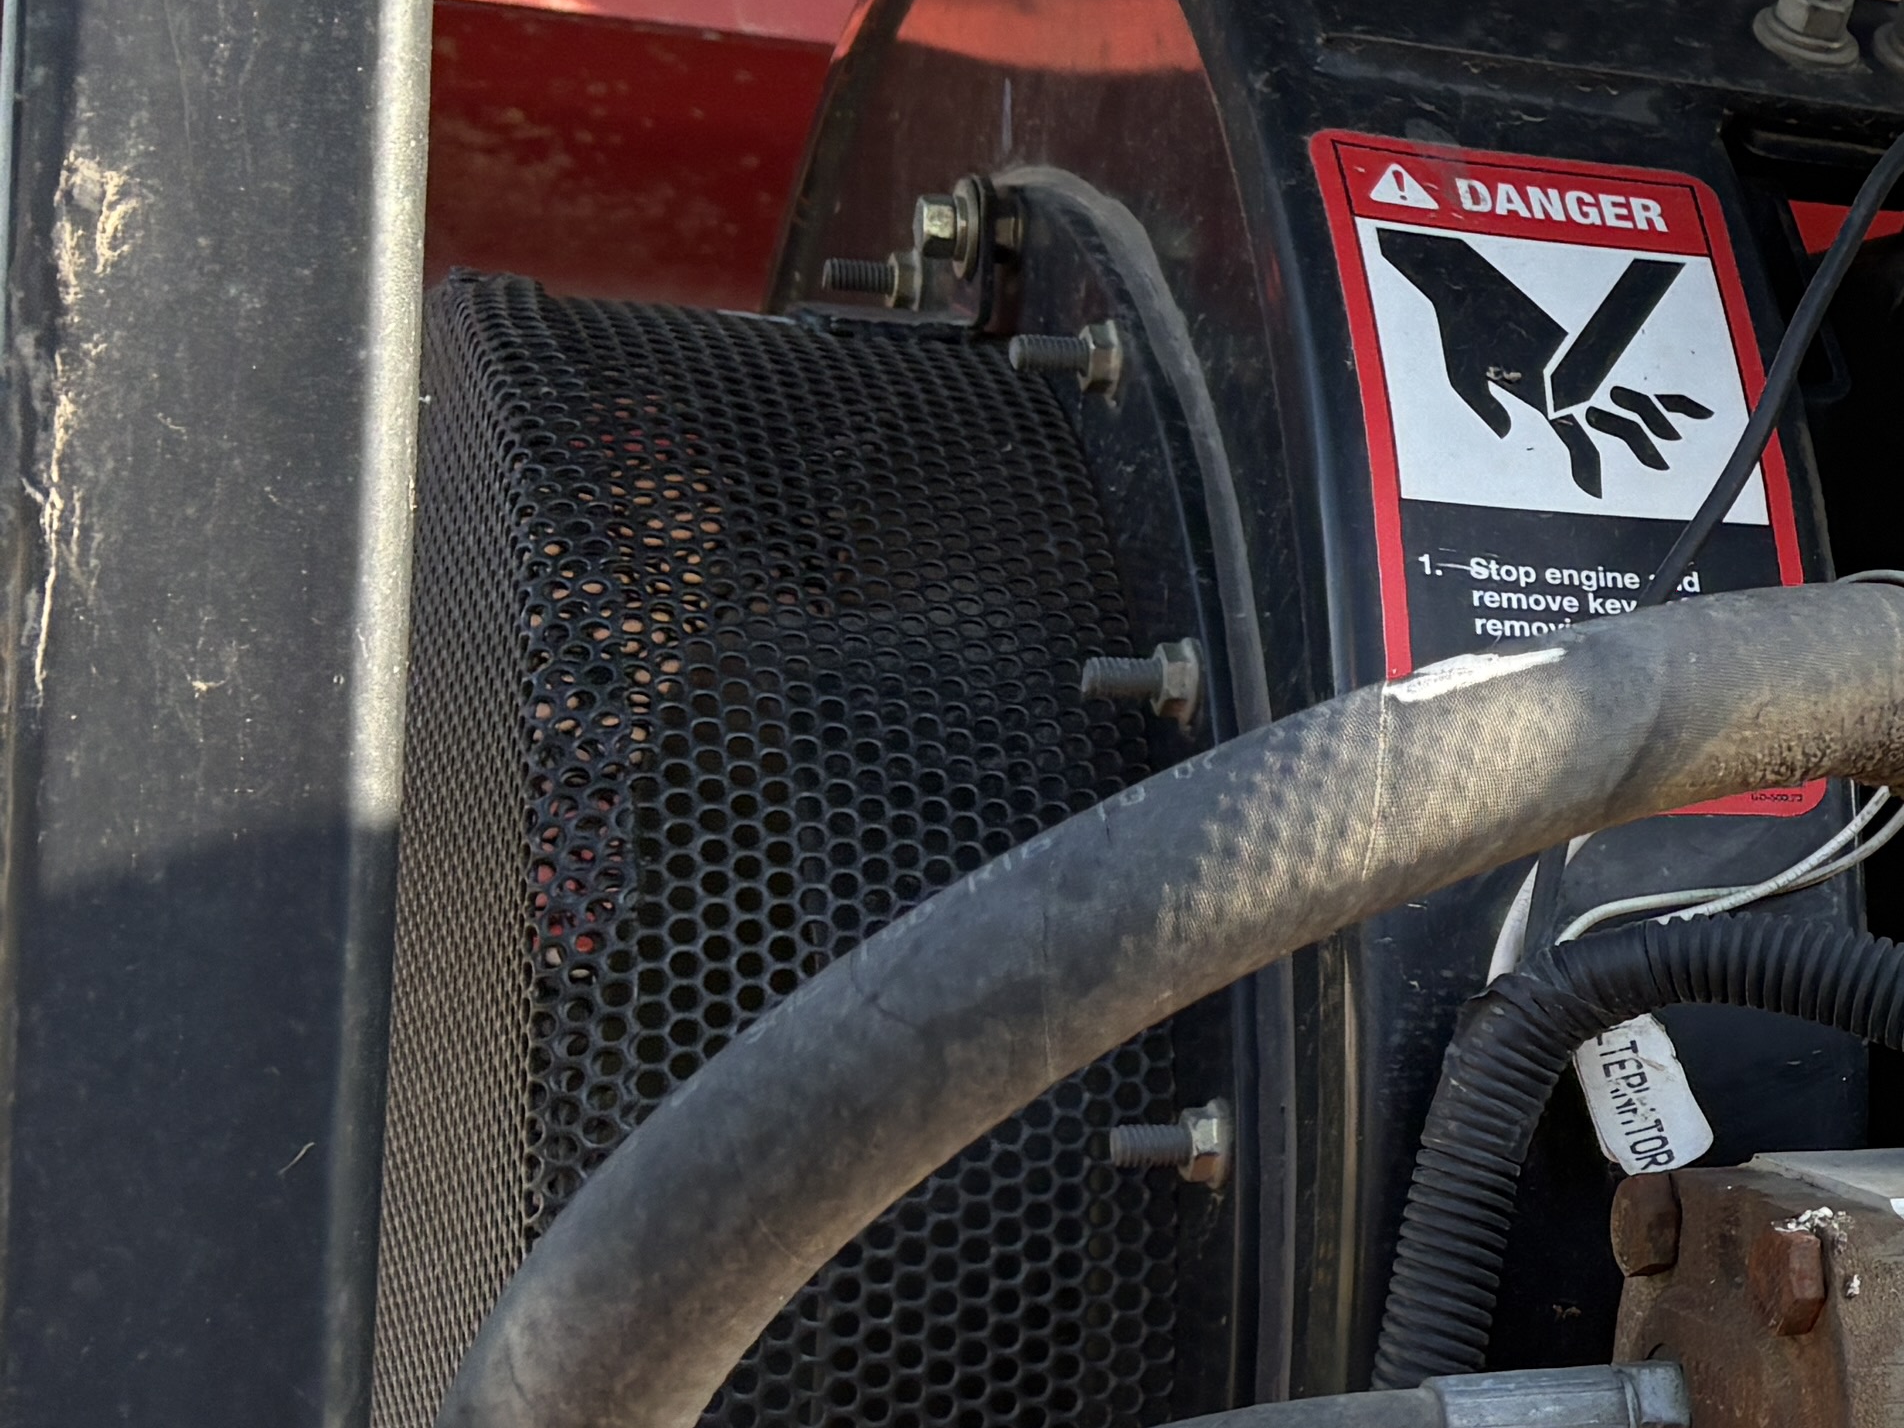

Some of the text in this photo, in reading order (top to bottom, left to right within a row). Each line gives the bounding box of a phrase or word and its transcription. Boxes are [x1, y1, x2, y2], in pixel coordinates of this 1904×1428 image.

[1455, 176, 1668, 233] DANGER
[1417, 552, 1443, 576] 1.
[1469, 556, 1537, 588] Stop
[1545, 565, 1641, 592] engine
[1471, 586, 1580, 613] remove
